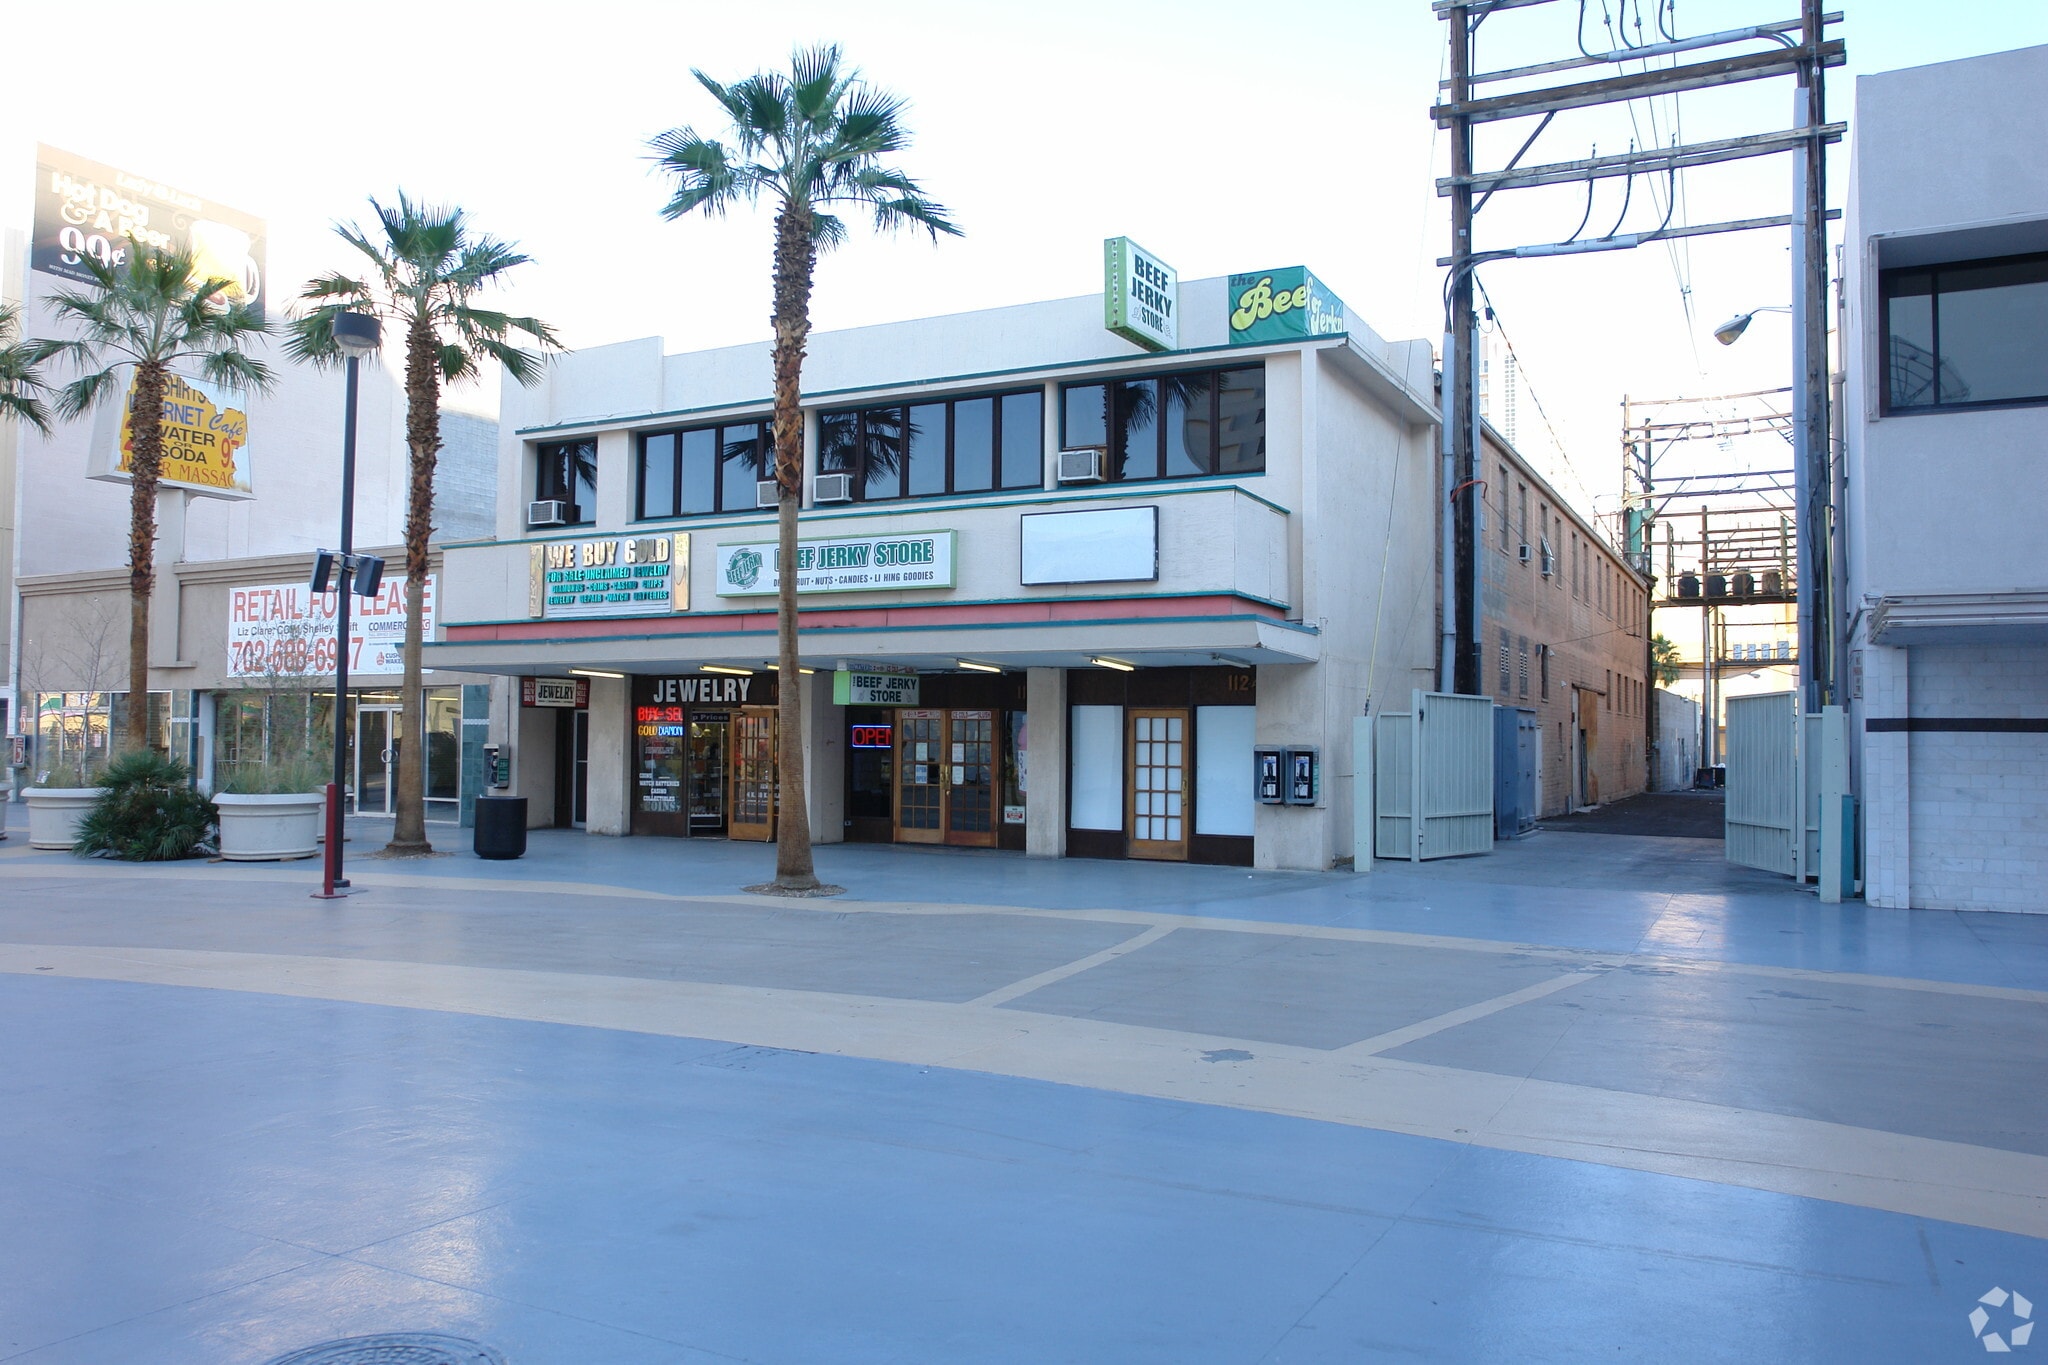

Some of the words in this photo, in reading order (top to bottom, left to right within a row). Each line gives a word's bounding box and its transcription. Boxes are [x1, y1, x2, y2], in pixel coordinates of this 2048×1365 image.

[52, 171, 97, 207] Hot
[100, 187, 149, 226] Dog
[93, 210, 114, 233] A
[119, 215, 171, 250] Beer
[1134, 253, 1168, 294] BEEF
[1231, 274, 1255, 287] the
[1131, 279, 1172, 318] JERKY
[1230, 276, 1313, 331] Beef
[1141, 307, 1164, 334] STORE
[209, 413, 245, 442] Café
[161, 444, 207, 465] SODA
[173, 441, 193, 449] OR
[547, 544, 575, 569] WE
[582, 541, 618, 567] BUY
[624, 538, 670, 564] GOLD
[818, 544, 870, 569] JERKY
[875, 541, 933, 567] STORE
[547, 571, 563, 583] FOR
[633, 564, 670, 578] JEWELRY
[815, 576, 833, 586] NUTS
[839, 574, 868, 584] CANDIES
[874, 573, 880, 582] LI
[883, 573, 900, 582] HING
[903, 571, 934, 581] GOODIES
[552, 584, 585, 593] DIAMONDS
[642, 579, 664, 589] CHIPS
[234, 587, 303, 622] RETAIL
[309, 585, 351, 618] FO
[548, 595, 576, 605] JEWELRY
[579, 594, 603, 603] REPAIR
[633, 591, 669, 601] BATTERIES
[238, 627, 249, 636] Liz
[303, 623, 334, 635] Shelley
[232, 636, 364, 673] 702-688-697
[538, 685, 574, 699] JEWELRY
[653, 678, 751, 703] JEWELRY
[856, 676, 882, 688] BEEF
[886, 677, 917, 690] JERKY
[870, 690, 902, 703] STORE
[700, 713, 729, 721] Prices
[638, 725, 657, 737] GOLD
